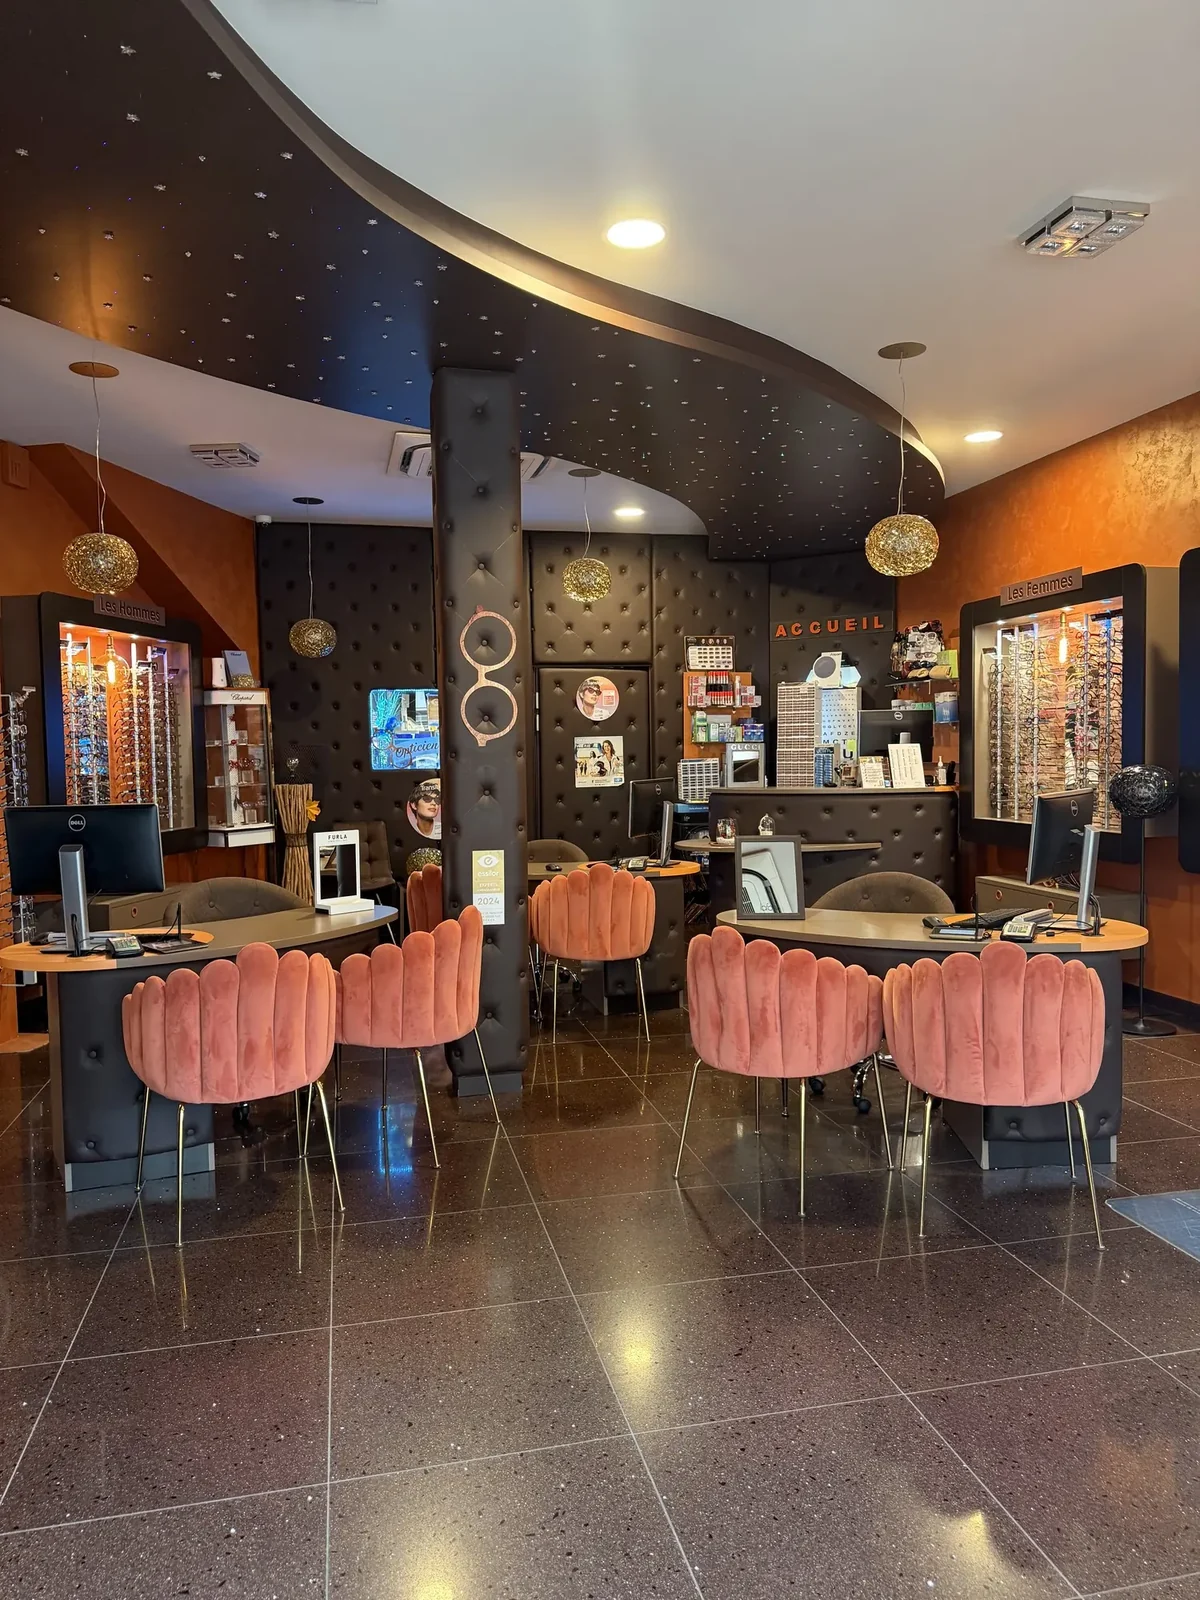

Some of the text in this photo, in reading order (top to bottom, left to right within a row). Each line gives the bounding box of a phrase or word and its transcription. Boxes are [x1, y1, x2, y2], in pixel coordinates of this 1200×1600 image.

[1007, 575, 1073, 602] Les Femmes
[99, 596, 161, 623] Les Hommes
[775, 616, 884, 638] ACCUEIL
[230, 692, 255, 702] Chopard
[395, 741, 439, 758] Opticien
[730, 743, 760, 752] GUCCI
[477, 897, 500, 906] 2024
